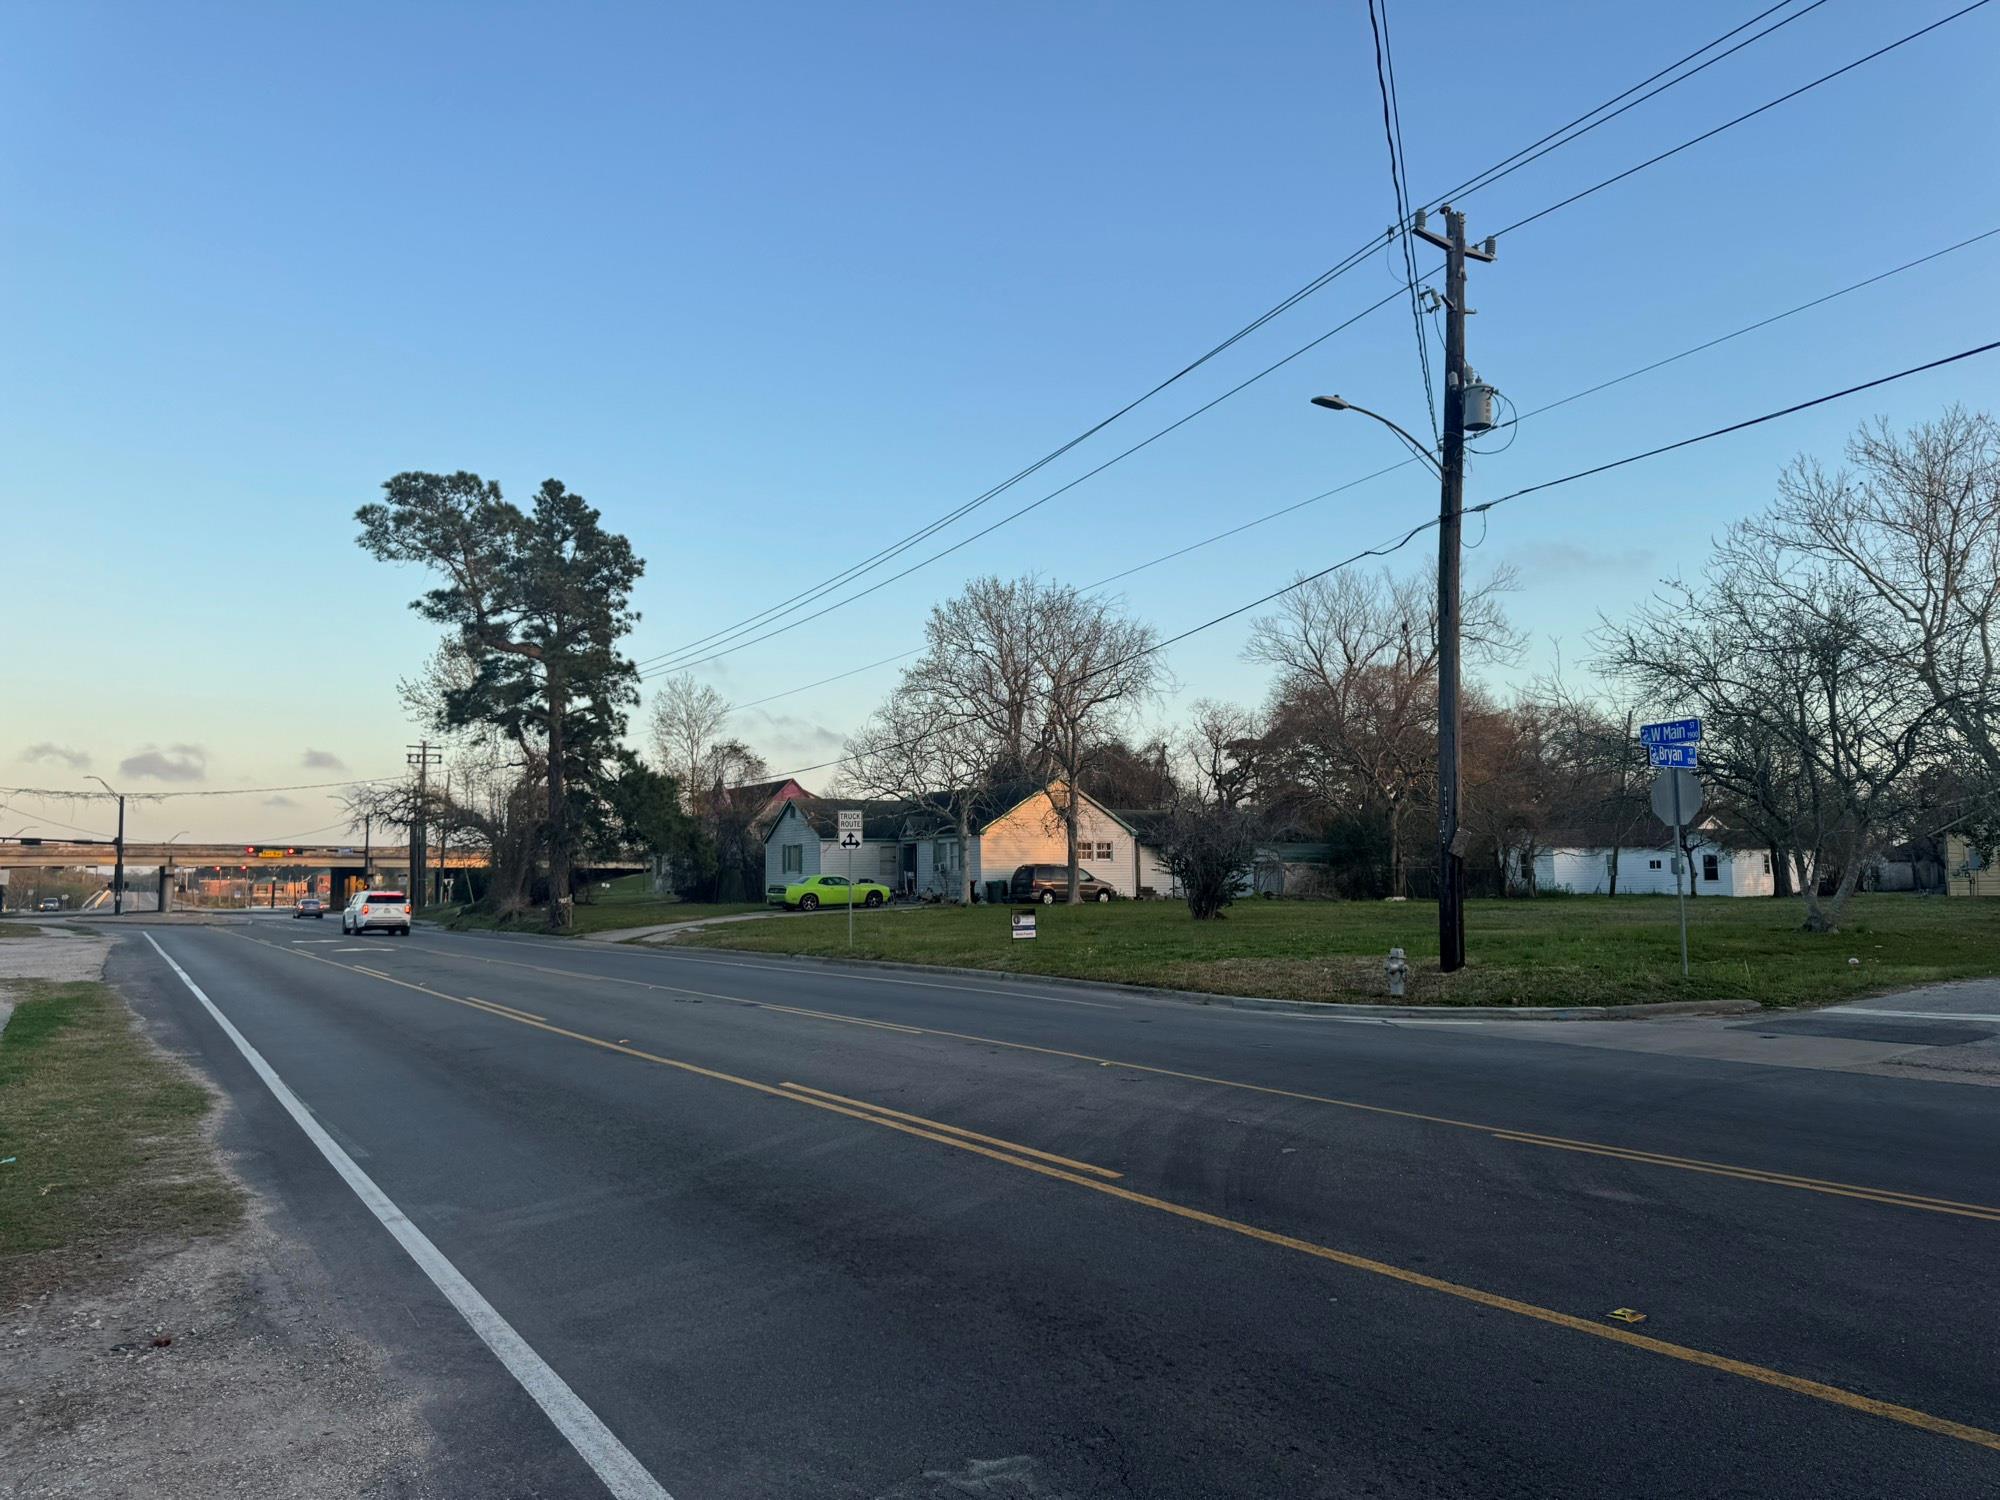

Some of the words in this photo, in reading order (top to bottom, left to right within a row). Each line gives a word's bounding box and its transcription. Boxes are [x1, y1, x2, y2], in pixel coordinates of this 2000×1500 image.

[1651, 727, 1660, 741] W
[1663, 723, 1685, 740] Main
[1659, 746, 1682, 765] Bryan
[840, 812, 860, 820] TRUCK
[840, 820, 861, 828] ROUTE
